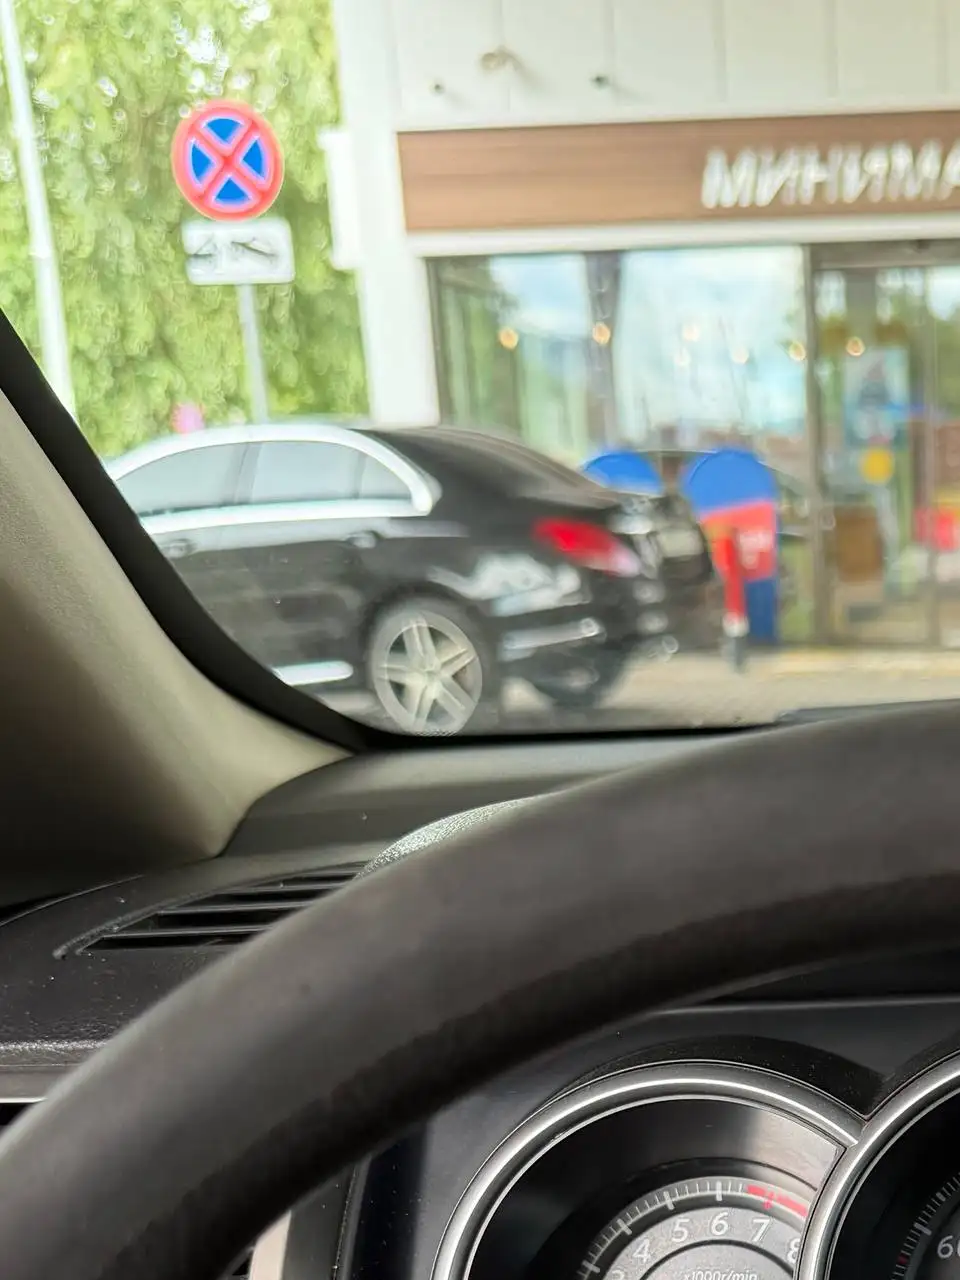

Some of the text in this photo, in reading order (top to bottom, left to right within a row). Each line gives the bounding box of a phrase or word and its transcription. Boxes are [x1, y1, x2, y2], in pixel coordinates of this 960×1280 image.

[671, 1218, 690, 1243] 5
[709, 1211, 729, 1236] 6
[751, 1217, 771, 1242] 7
[632, 1238, 651, 1263] 4
